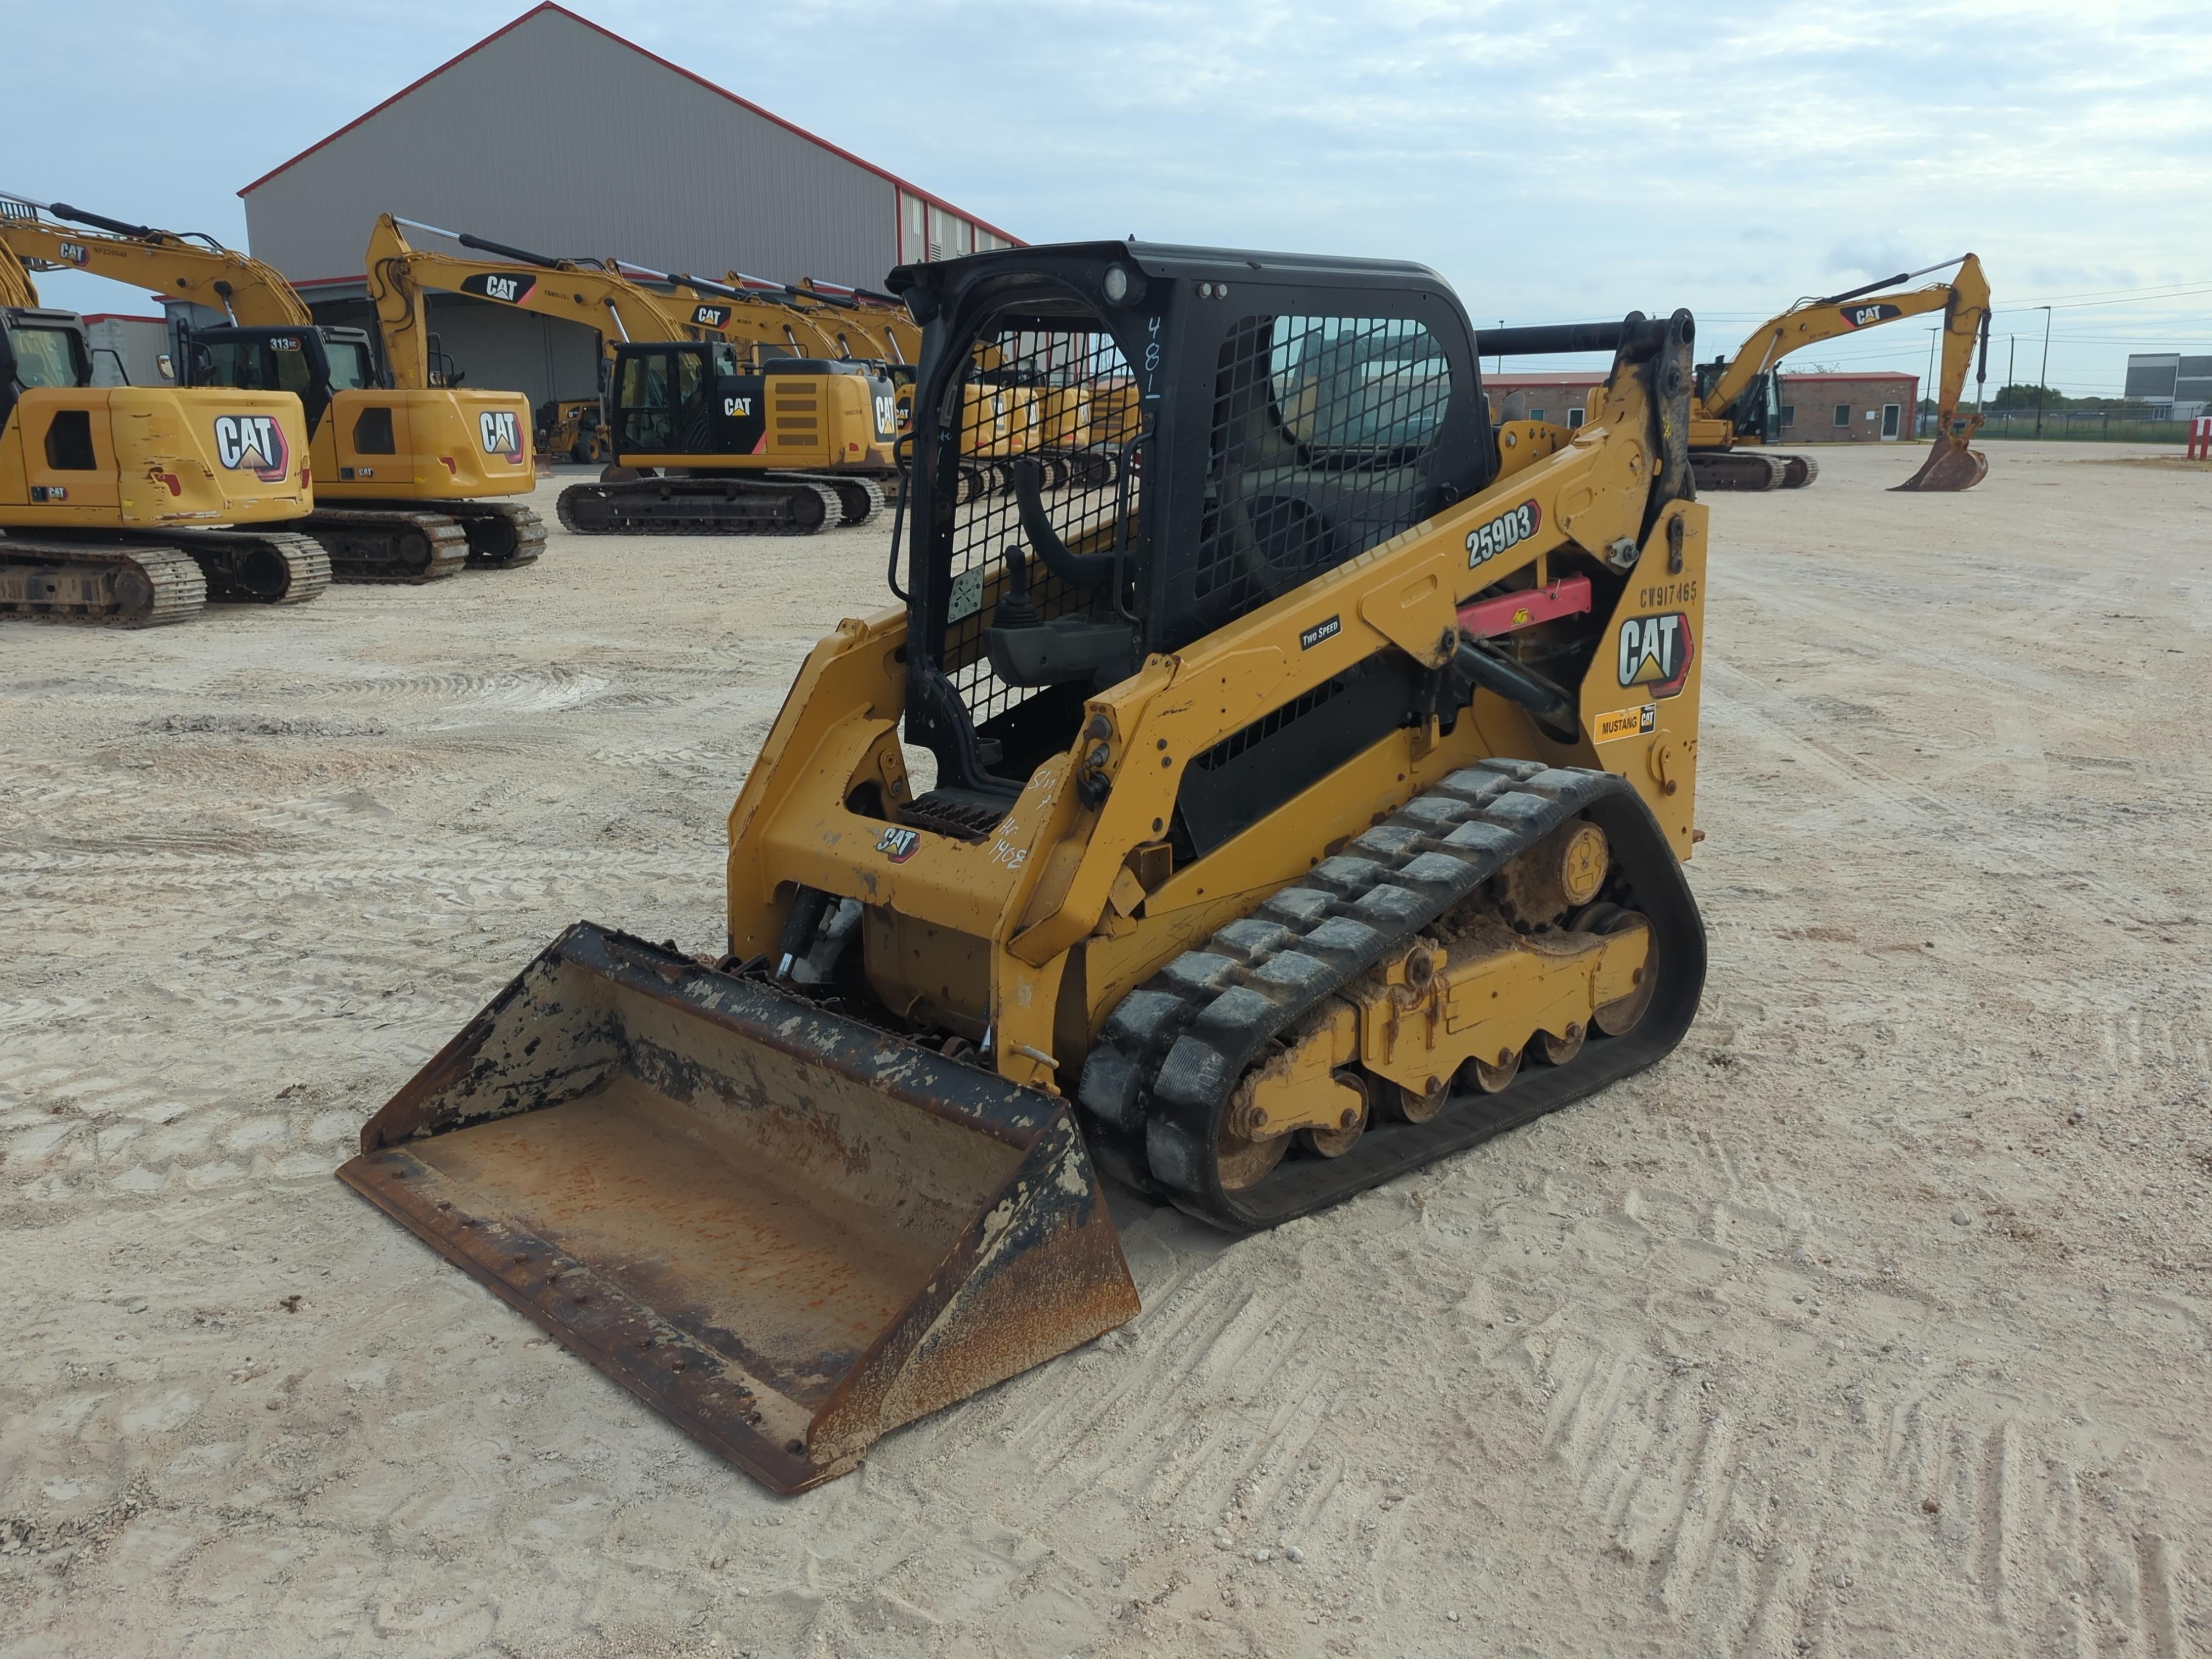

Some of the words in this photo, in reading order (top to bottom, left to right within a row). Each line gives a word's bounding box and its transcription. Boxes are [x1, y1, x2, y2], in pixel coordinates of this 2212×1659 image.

[60, 242, 83, 261] CAT
[487, 275, 517, 301] CAT
[698, 308, 720, 325] CAT
[1856, 305, 1881, 325] CAT
[270, 338, 289, 349] 313
[724, 398, 751, 416] CAT
[876, 396, 895, 434] CAT
[216, 417, 273, 467] CAT
[480, 413, 516, 453] CAT
[359, 468, 372, 477] CAT
[49, 487, 64, 498] CAT
[1467, 505, 1531, 567] 259D3
[1620, 615, 1678, 685] CAT
[1602, 716, 1638, 735] MUSTANG
[1641, 711, 1654, 726] CAT
[877, 827, 916, 856] CAT
